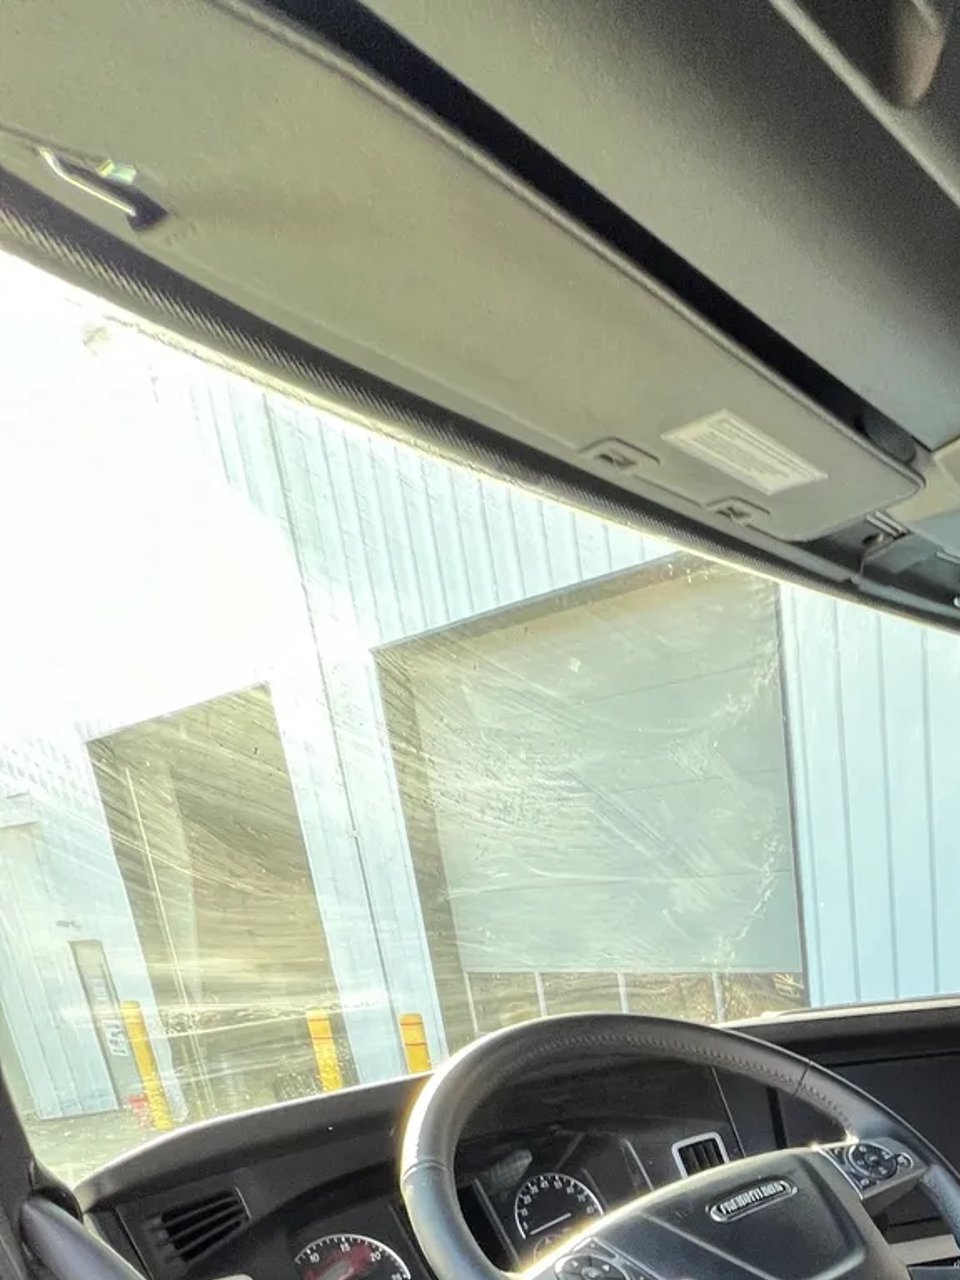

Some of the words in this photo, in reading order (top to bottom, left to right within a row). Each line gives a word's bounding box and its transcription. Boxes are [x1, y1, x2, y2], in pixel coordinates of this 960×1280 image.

[340, 1244, 351, 1253] 15
[309, 1252, 320, 1264] 10
[370, 1252, 382, 1262] 20
